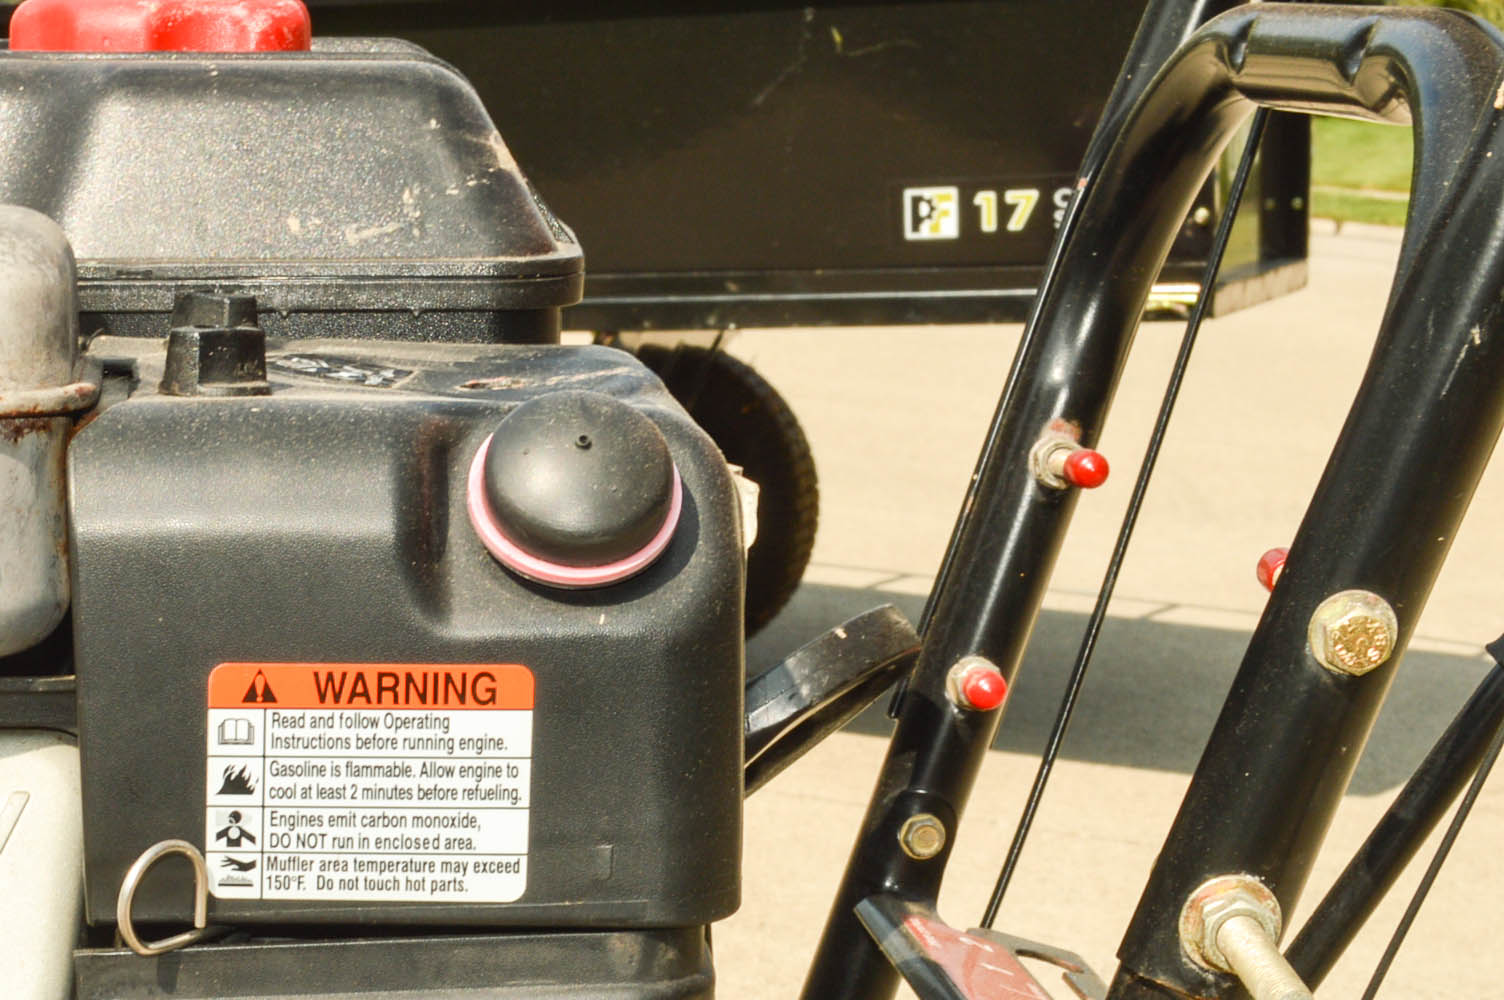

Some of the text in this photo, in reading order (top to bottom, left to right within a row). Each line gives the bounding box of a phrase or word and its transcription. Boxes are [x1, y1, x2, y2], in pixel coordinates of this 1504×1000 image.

[973, 189, 1040, 233] 17
[313, 671, 497, 706] WARNING
[271, 711, 450, 733] Read and follow Operating
[271, 732, 508, 754] Instructions before running engine.
[269, 759, 519, 783] Gasoline is flammable. Allow engine to
[268, 782, 522, 806] cool at least 2 minutes before refueling.
[269, 810, 324, 832] Engines
[327, 811, 357, 828] emit
[360, 811, 408, 829] carbon
[269, 832, 476, 851] DO NOT run in enclosed area.
[266, 856, 521, 878] Muffler area temperature may exceed
[266, 874, 469, 895] 150°F. Do not touch hot parts.
